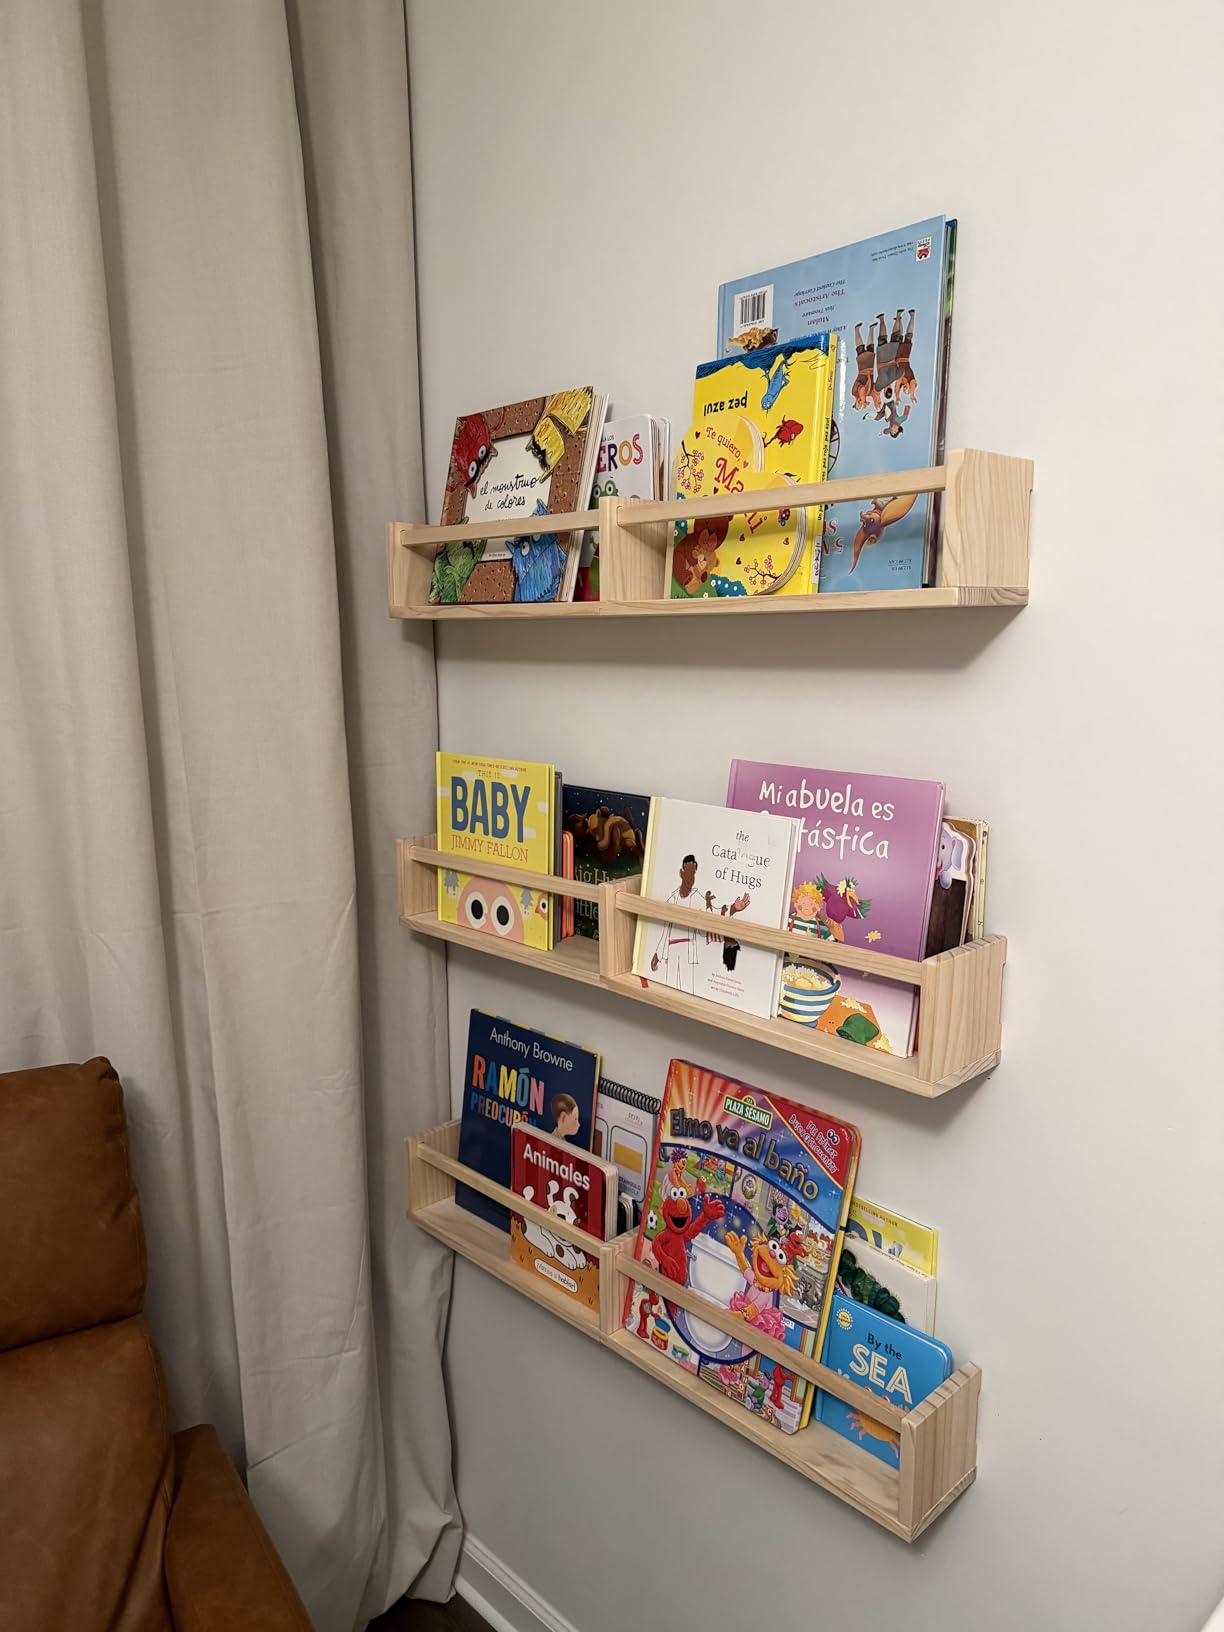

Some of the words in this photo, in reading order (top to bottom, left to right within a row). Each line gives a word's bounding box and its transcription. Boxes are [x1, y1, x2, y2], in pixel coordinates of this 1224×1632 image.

[703, 401, 725, 416] azul
[728, 390, 748, 410] pez
[706, 426, 716, 439] Te
[718, 434, 741, 462] quiero,
[480, 480, 489, 495] el
[490, 474, 540, 494] monstruo
[484, 499, 493, 511] de
[497, 494, 525, 509] colores
[478, 769, 492, 778] THIS
[451, 775, 531, 843] BABY
[759, 780, 782, 804] Mi
[786, 778, 864, 817] abuela
[872, 802, 895, 821] es
[451, 834, 484, 852] JIMMY
[487, 841, 528, 863] FALLON
[736, 830, 750, 842] the
[798, 817, 889, 860] tástica
[715, 867, 729, 880] of
[730, 870, 762, 890] Hugs
[576, 898, 599, 920] ittle
[490, 1026, 531, 1059] Anthony
[532, 1042, 573, 1072] Browne
[472, 1055, 545, 1116] RAMÓN
[725, 1098, 744, 1116] PLAZA
[523, 1143, 590, 1190] Animales
[670, 1108, 713, 1141] Elmo
[716, 1124, 740, 1151] va
[743, 1133, 766, 1159] al
[764, 1139, 819, 1200] baño
[868, 1333, 881, 1350] By
[885, 1344, 902, 1360] the
[849, 1344, 912, 1404] SEA
